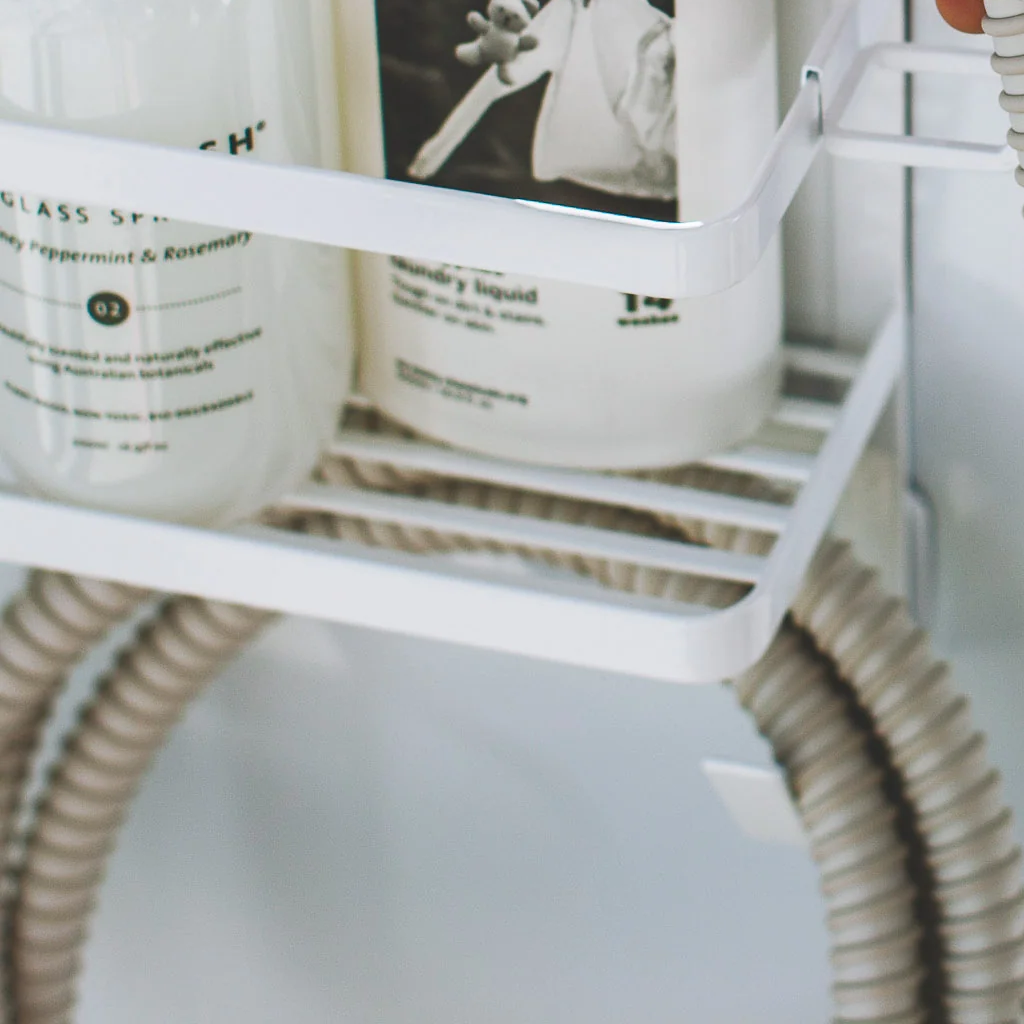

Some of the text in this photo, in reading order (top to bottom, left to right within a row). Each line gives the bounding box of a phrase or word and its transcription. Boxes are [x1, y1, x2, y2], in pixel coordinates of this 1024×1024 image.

[0, 190, 89, 225] GLASS
[29, 239, 135, 265] Peppermint
[140, 248, 157, 264] &
[163, 229, 253, 262] Rosemary
[474, 276, 539, 305] liquid
